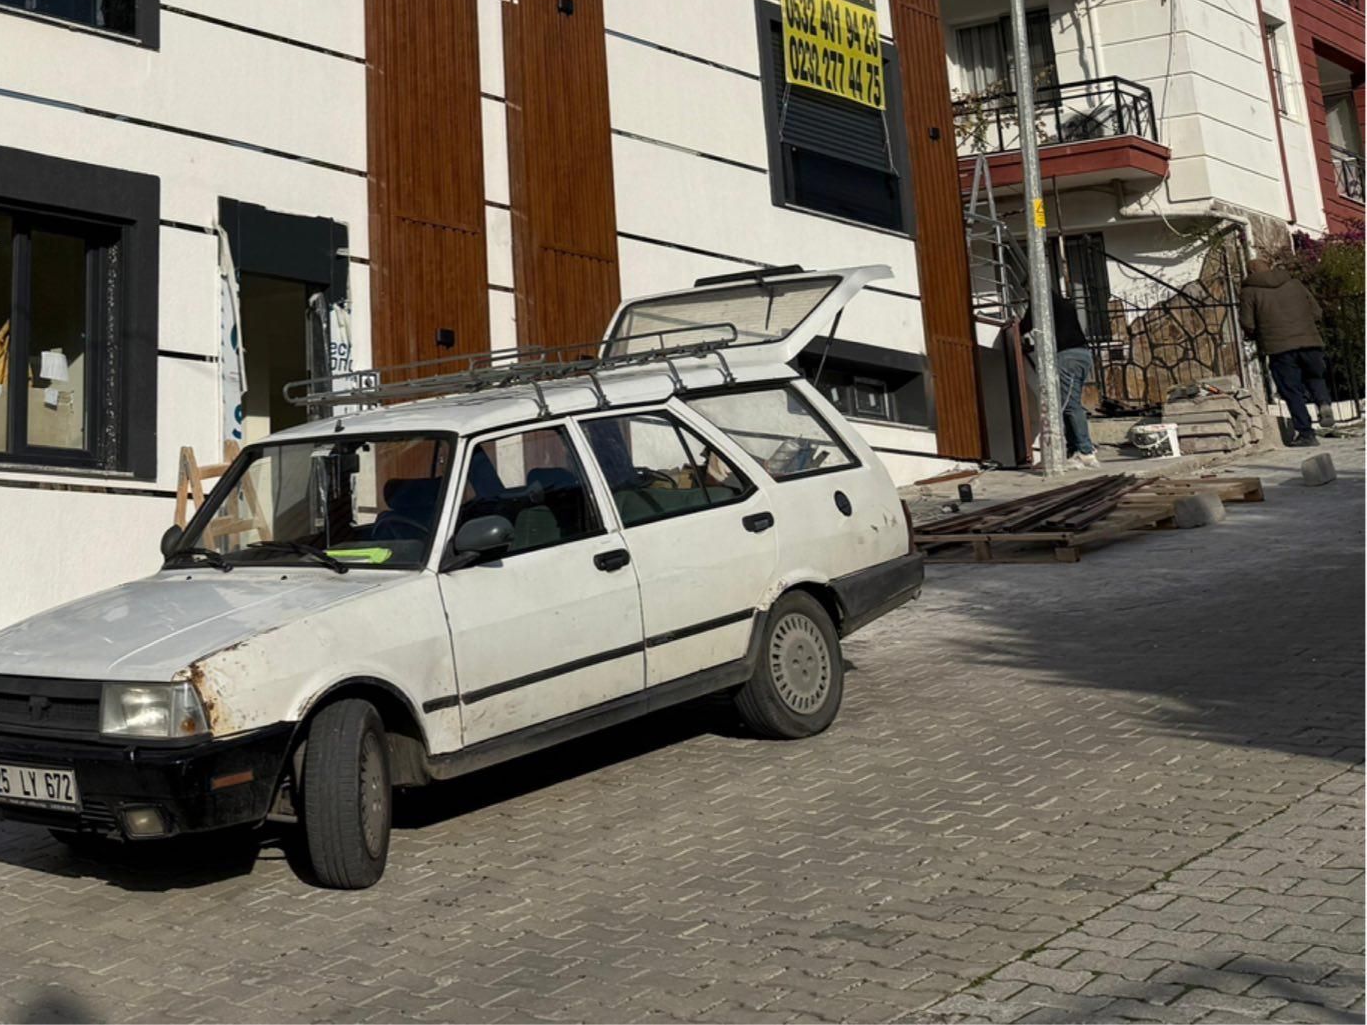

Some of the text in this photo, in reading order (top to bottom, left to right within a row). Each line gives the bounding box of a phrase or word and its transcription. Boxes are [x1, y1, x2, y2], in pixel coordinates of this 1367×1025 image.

[845, 6, 862, 51] 94
[862, 13, 878, 58] 23
[789, 35, 881, 107] 0232 277 44 75
[19, 769, 37, 797] LY
[44, 772, 73, 801] 672
